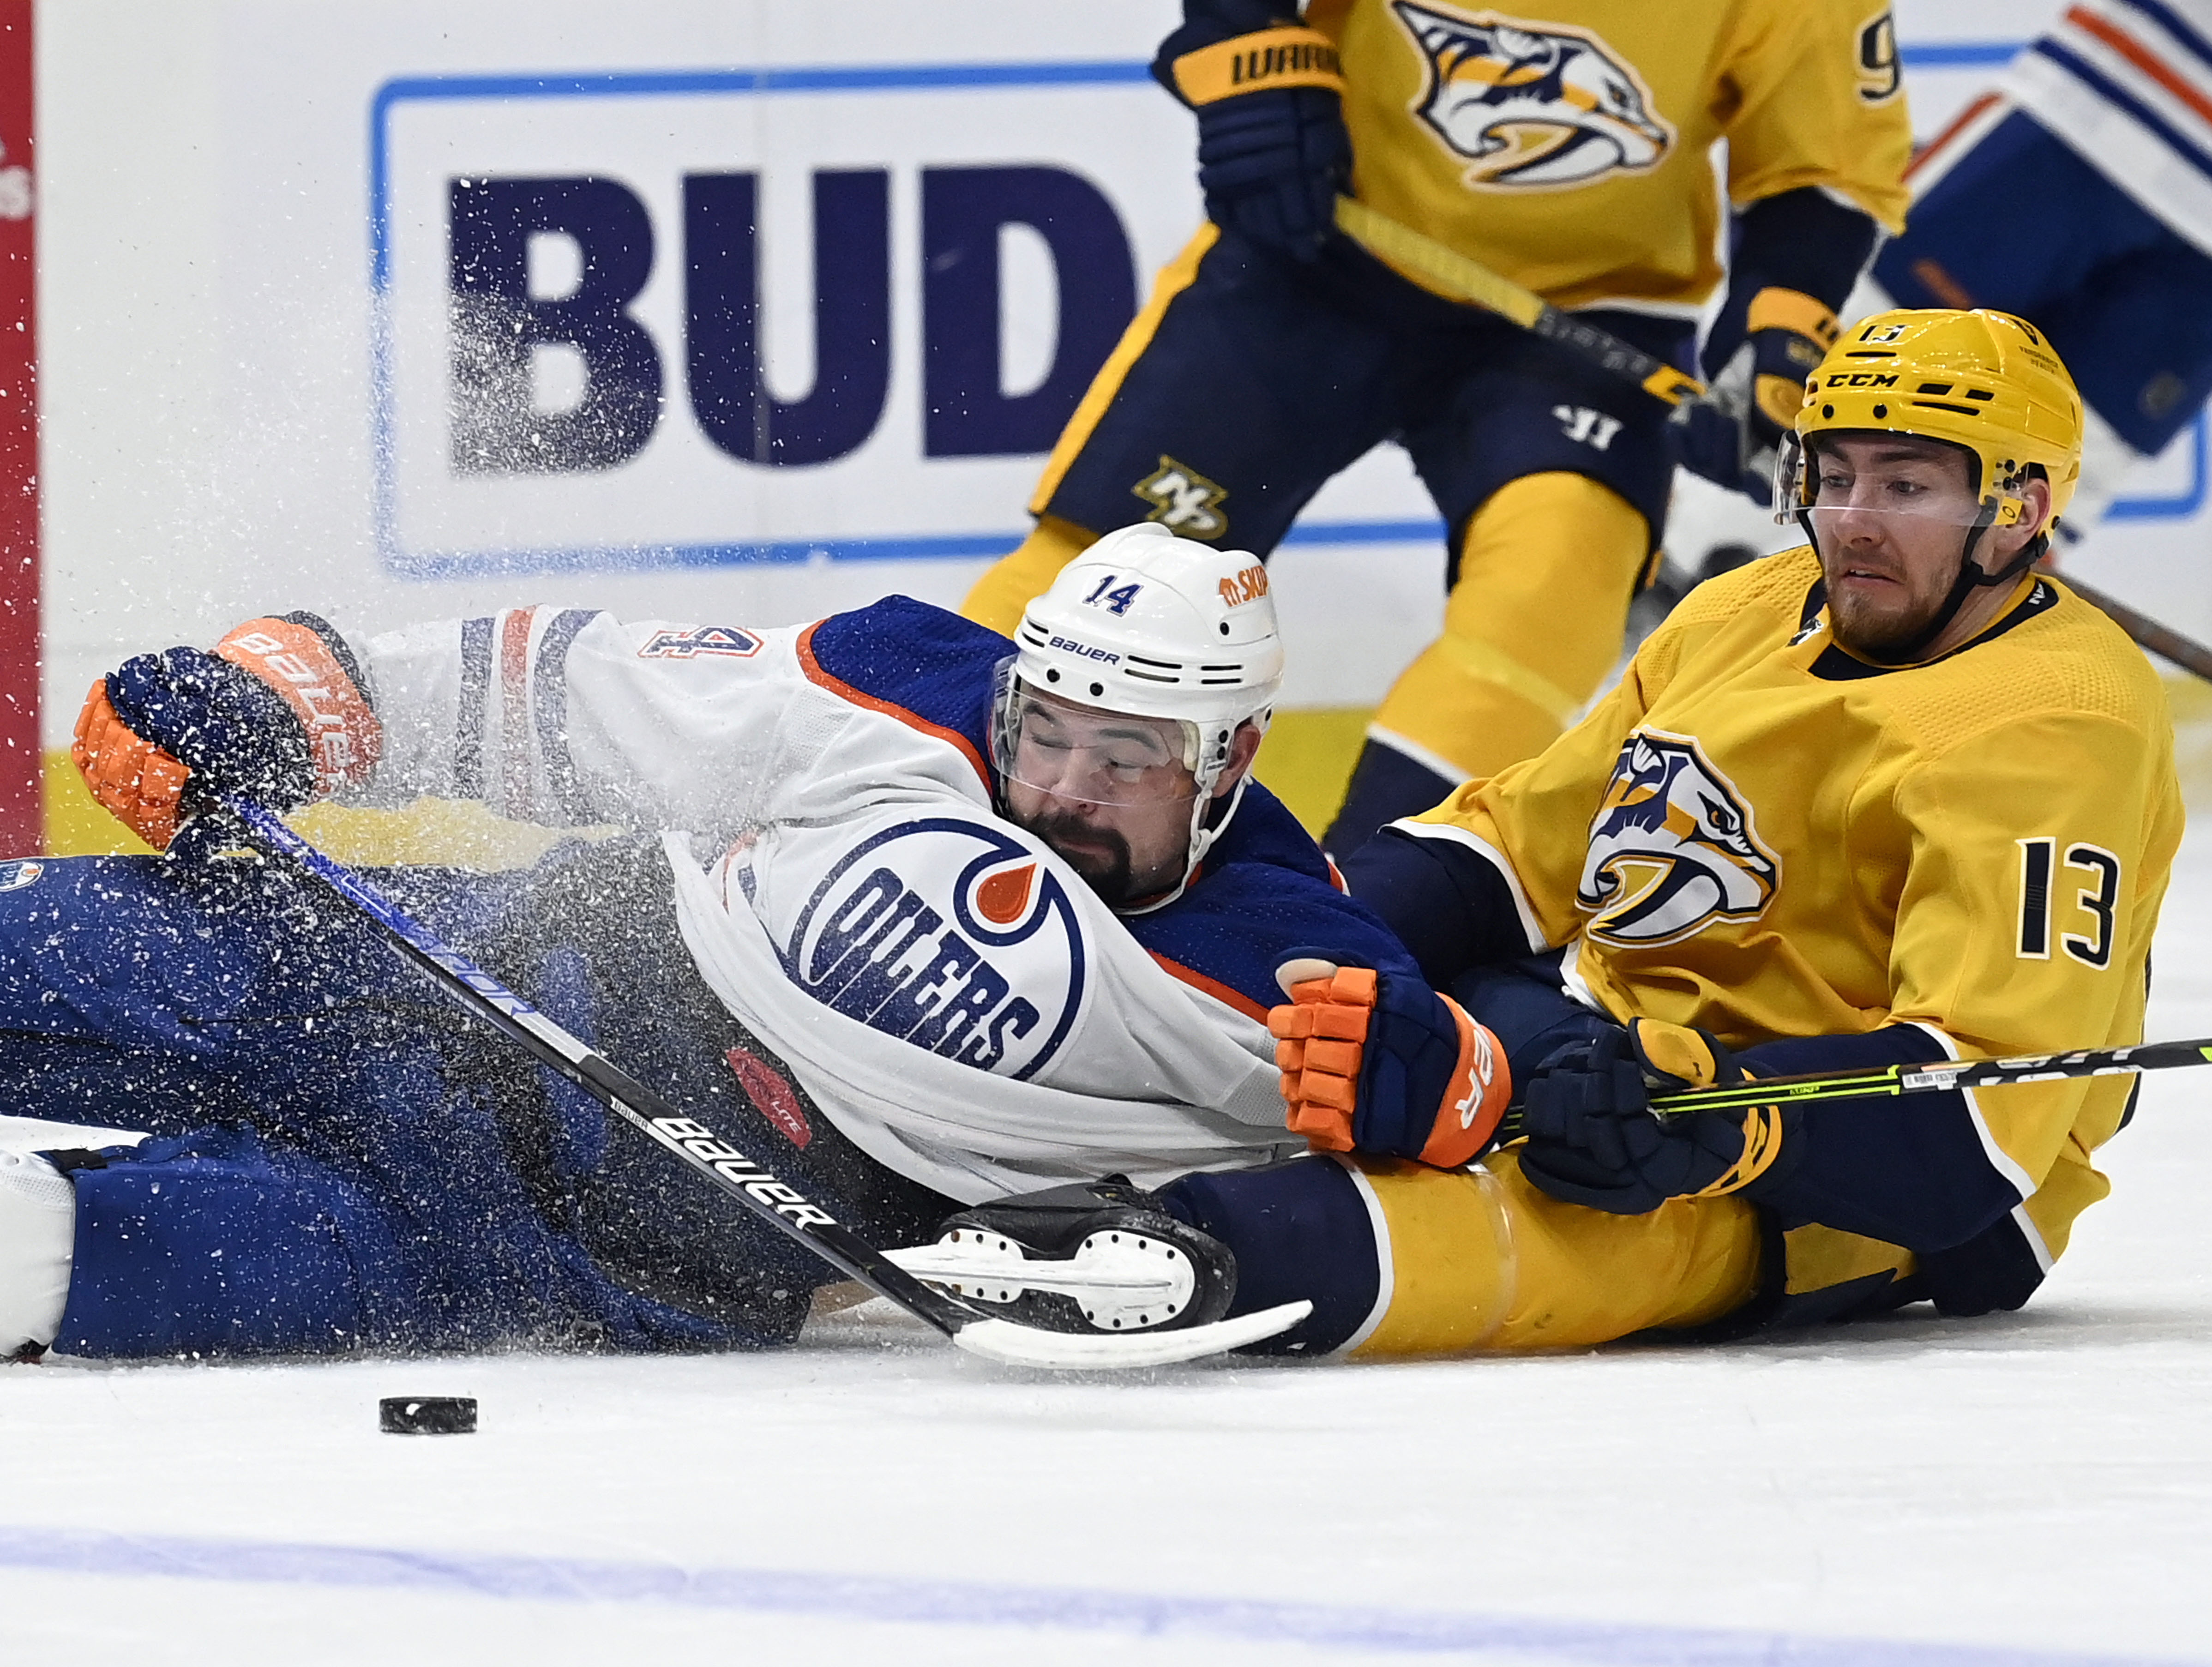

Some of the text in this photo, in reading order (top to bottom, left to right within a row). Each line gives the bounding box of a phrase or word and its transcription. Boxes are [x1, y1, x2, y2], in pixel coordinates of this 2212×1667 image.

[1857, 9, 1902, 100] 9
[447, 162, 1138, 478] BUD
[1826, 373, 1900, 387] CCM
[1082, 575, 1144, 617] 14
[1049, 636, 1121, 666] BAUER
[2010, 836, 2122, 971] 13
[809, 866, 1040, 1072] OILERS
[651, 1117, 838, 1231] BAUER
